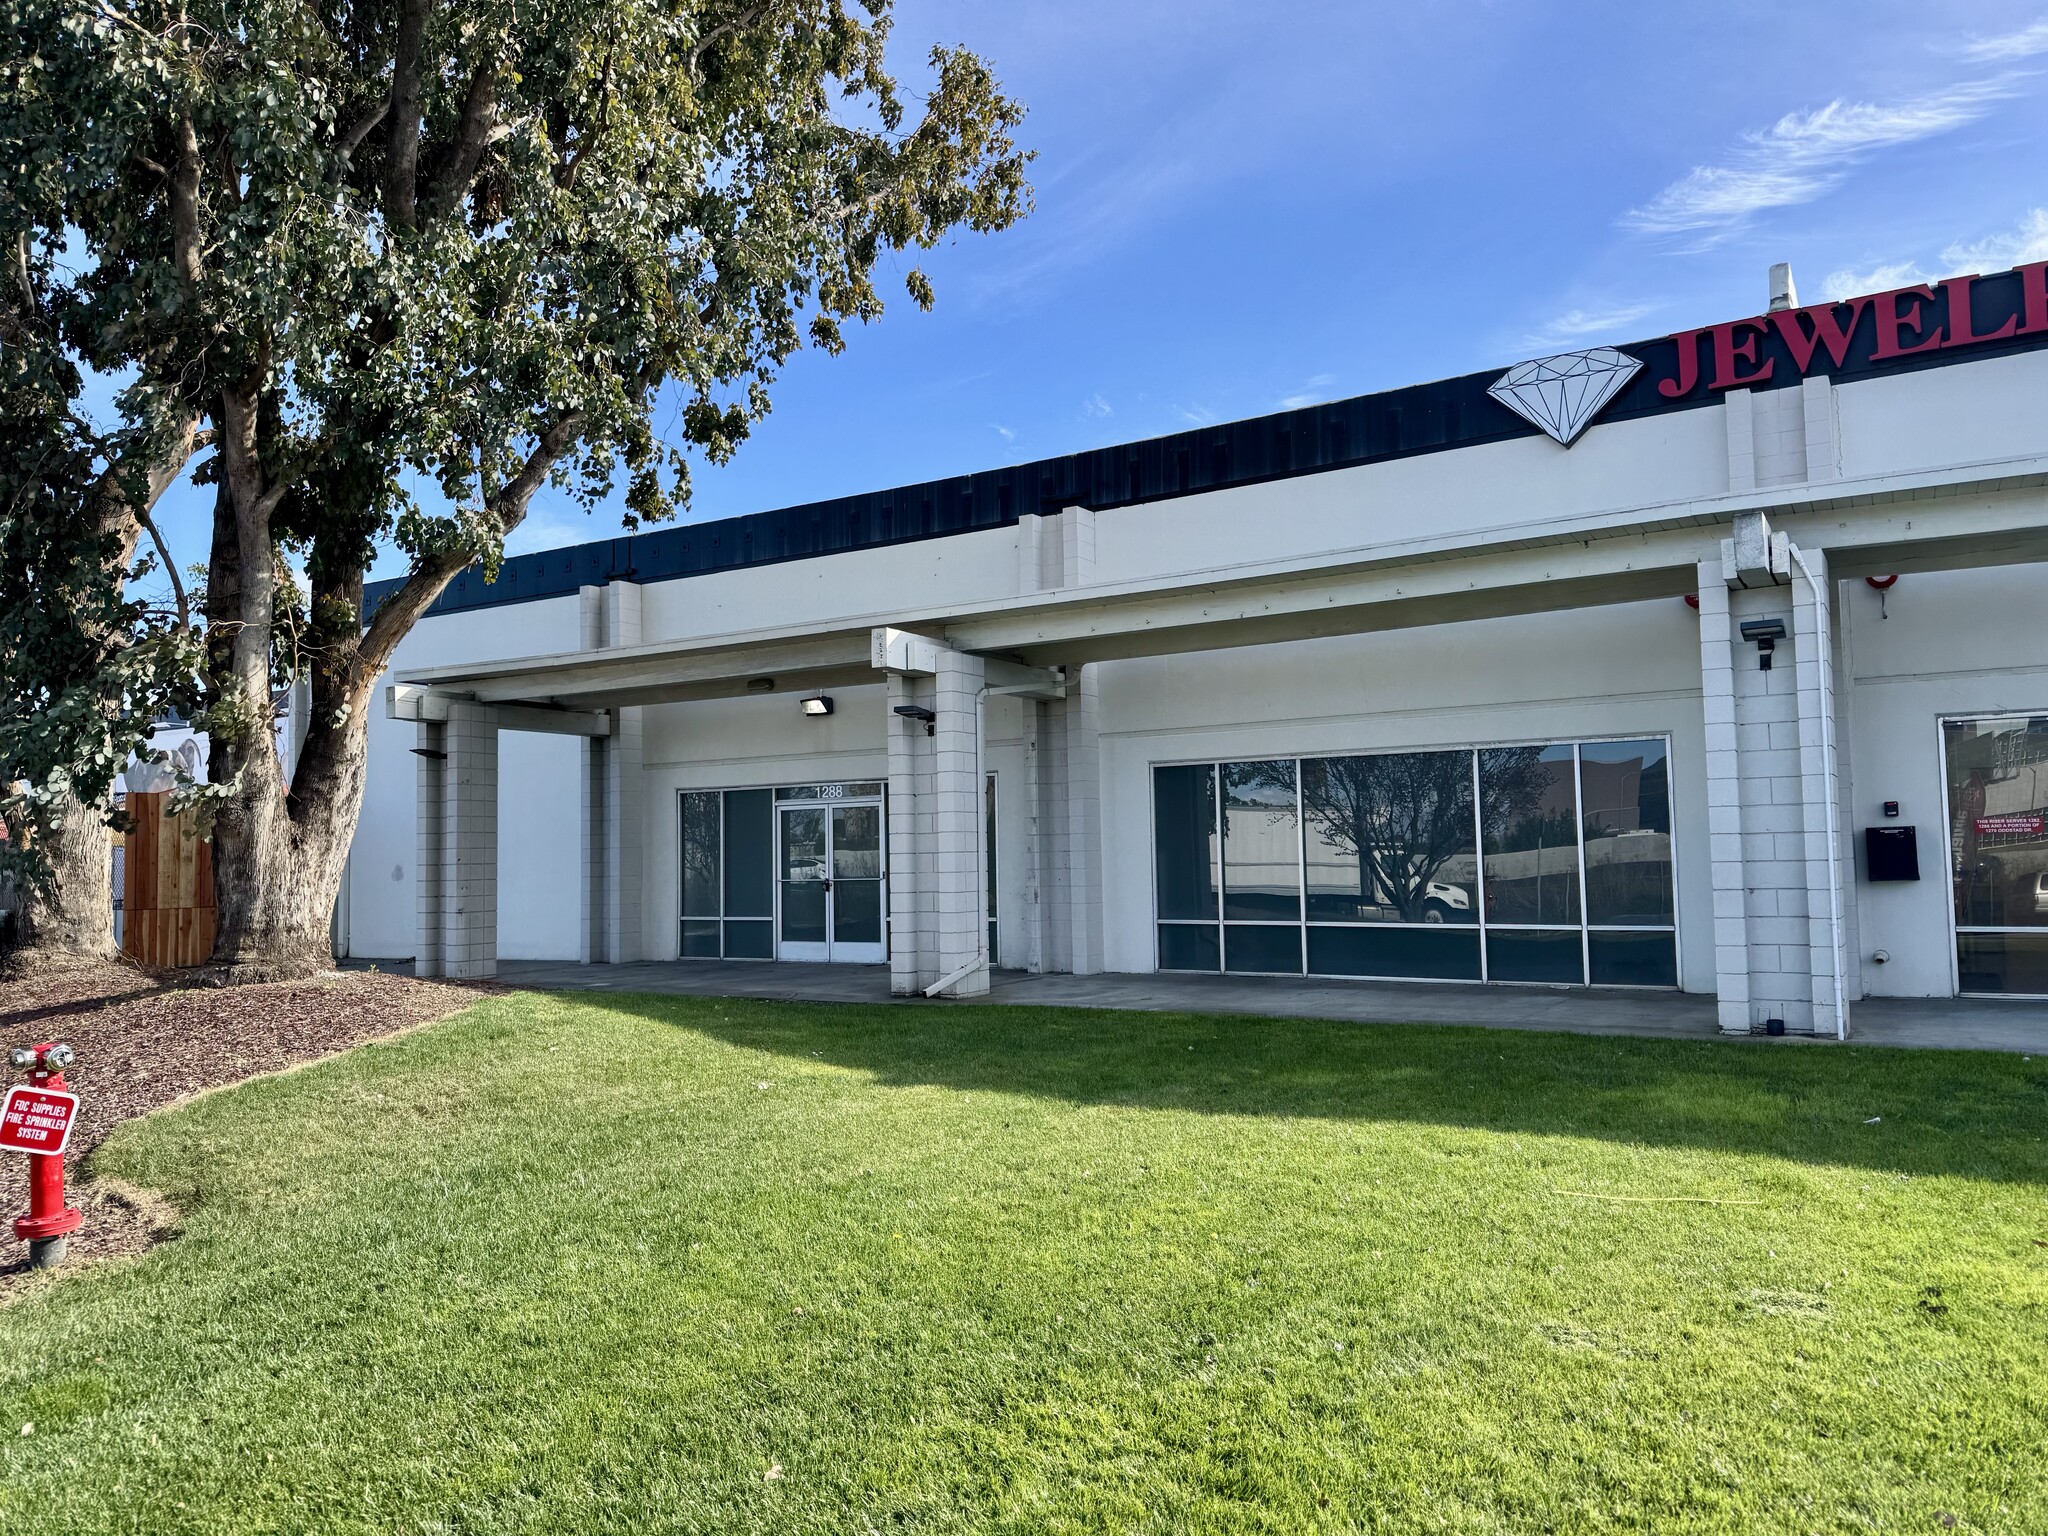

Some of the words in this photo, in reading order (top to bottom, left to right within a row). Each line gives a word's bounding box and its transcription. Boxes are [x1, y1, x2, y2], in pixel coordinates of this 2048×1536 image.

[815, 785, 843, 798] 1288
[13, 1099, 30, 1112] FDC
[31, 1102, 67, 1117] SUPPLIES
[5, 1111, 25, 1124] FIRE
[25, 1114, 67, 1130] SPRINKLER
[16, 1126, 48, 1141] SYSTEM
